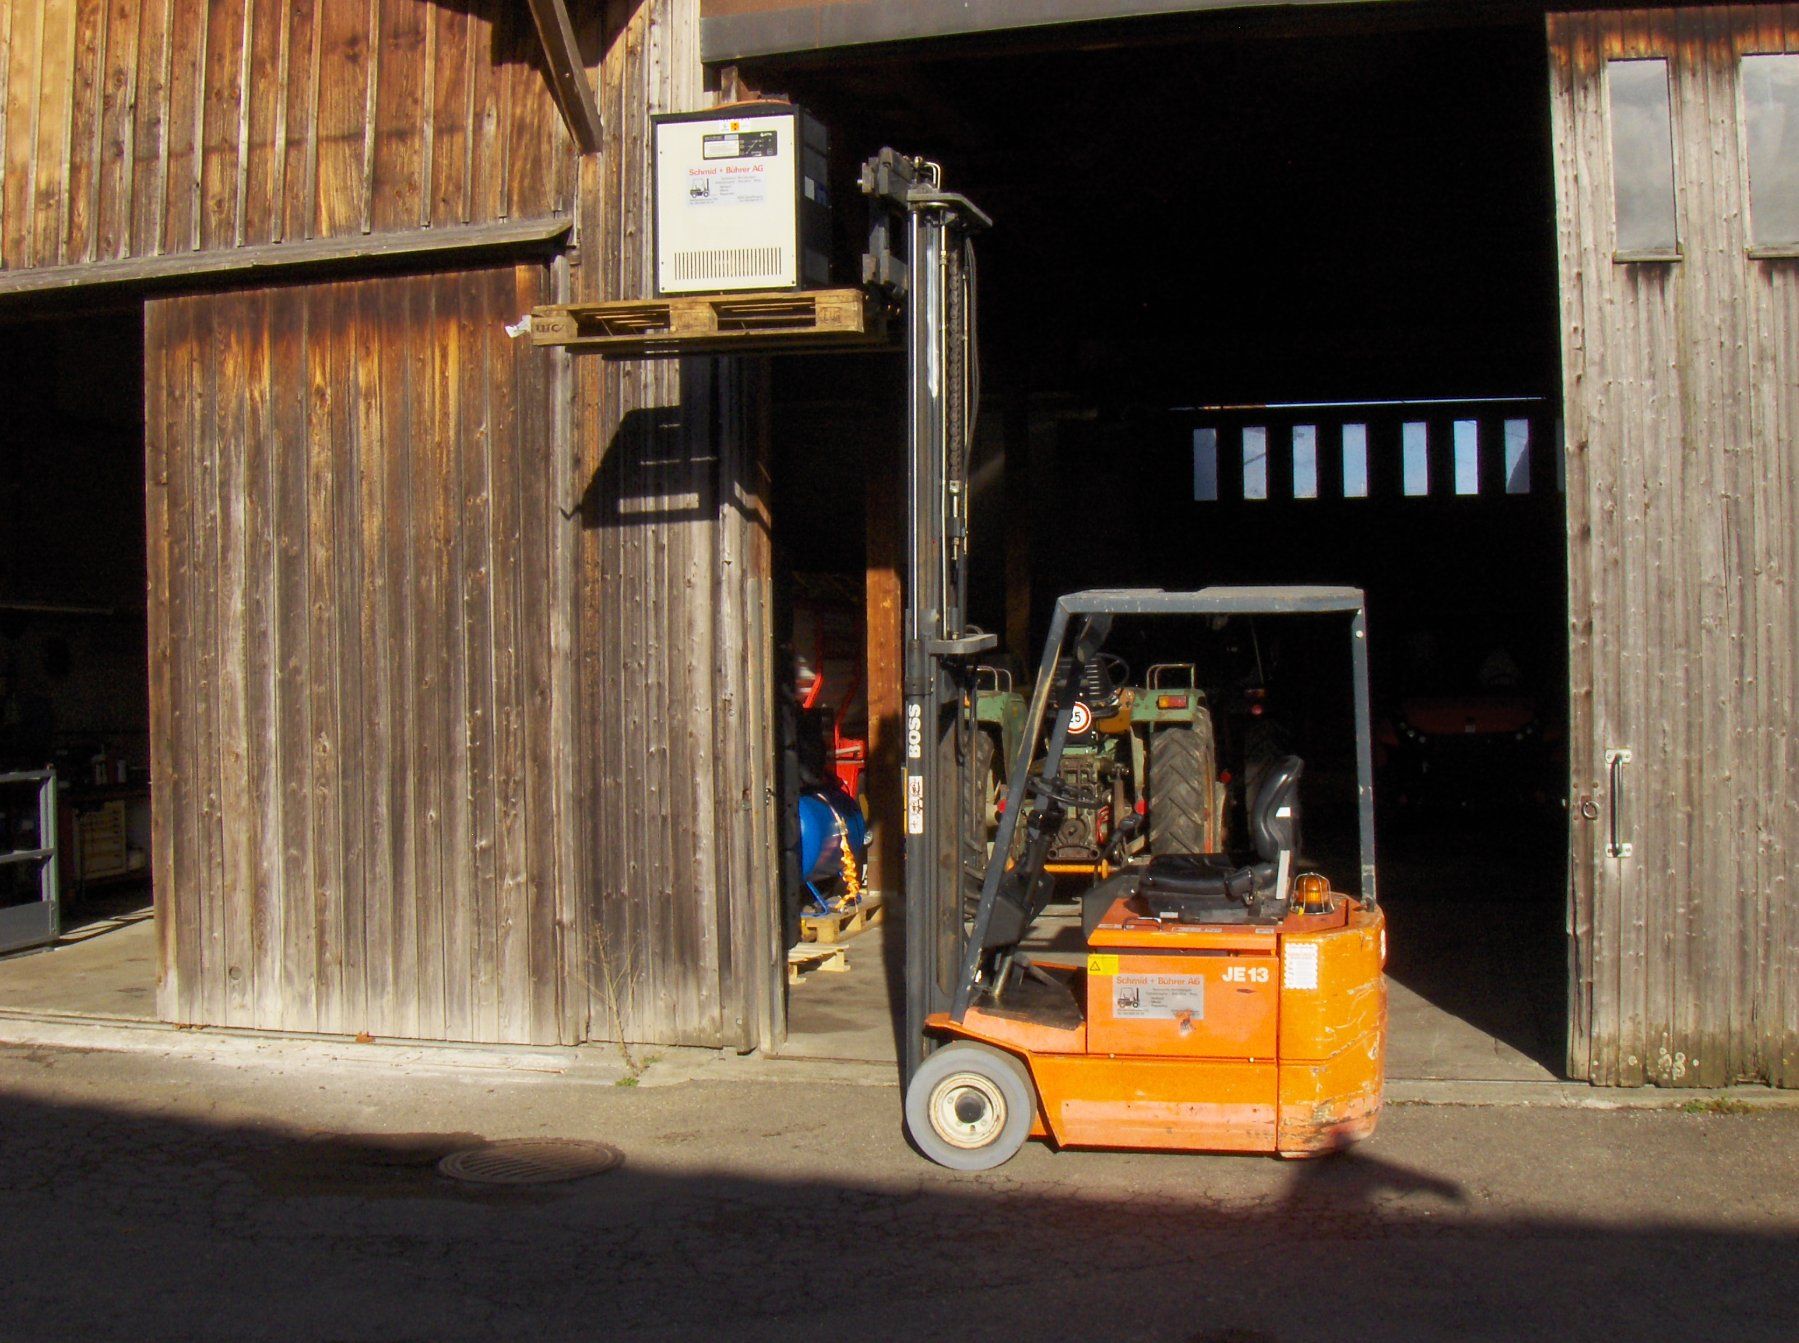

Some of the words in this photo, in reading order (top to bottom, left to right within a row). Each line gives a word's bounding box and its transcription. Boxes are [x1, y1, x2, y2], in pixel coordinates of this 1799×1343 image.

[689, 167, 717, 176] Schmid
[752, 164, 764, 172] AG
[908, 703, 921, 758] BOSS
[1116, 976, 1148, 985] Schmid
[1187, 977, 1201, 985] AG
[1221, 966, 1246, 983] JE
[1248, 967, 1269, 983] 13
